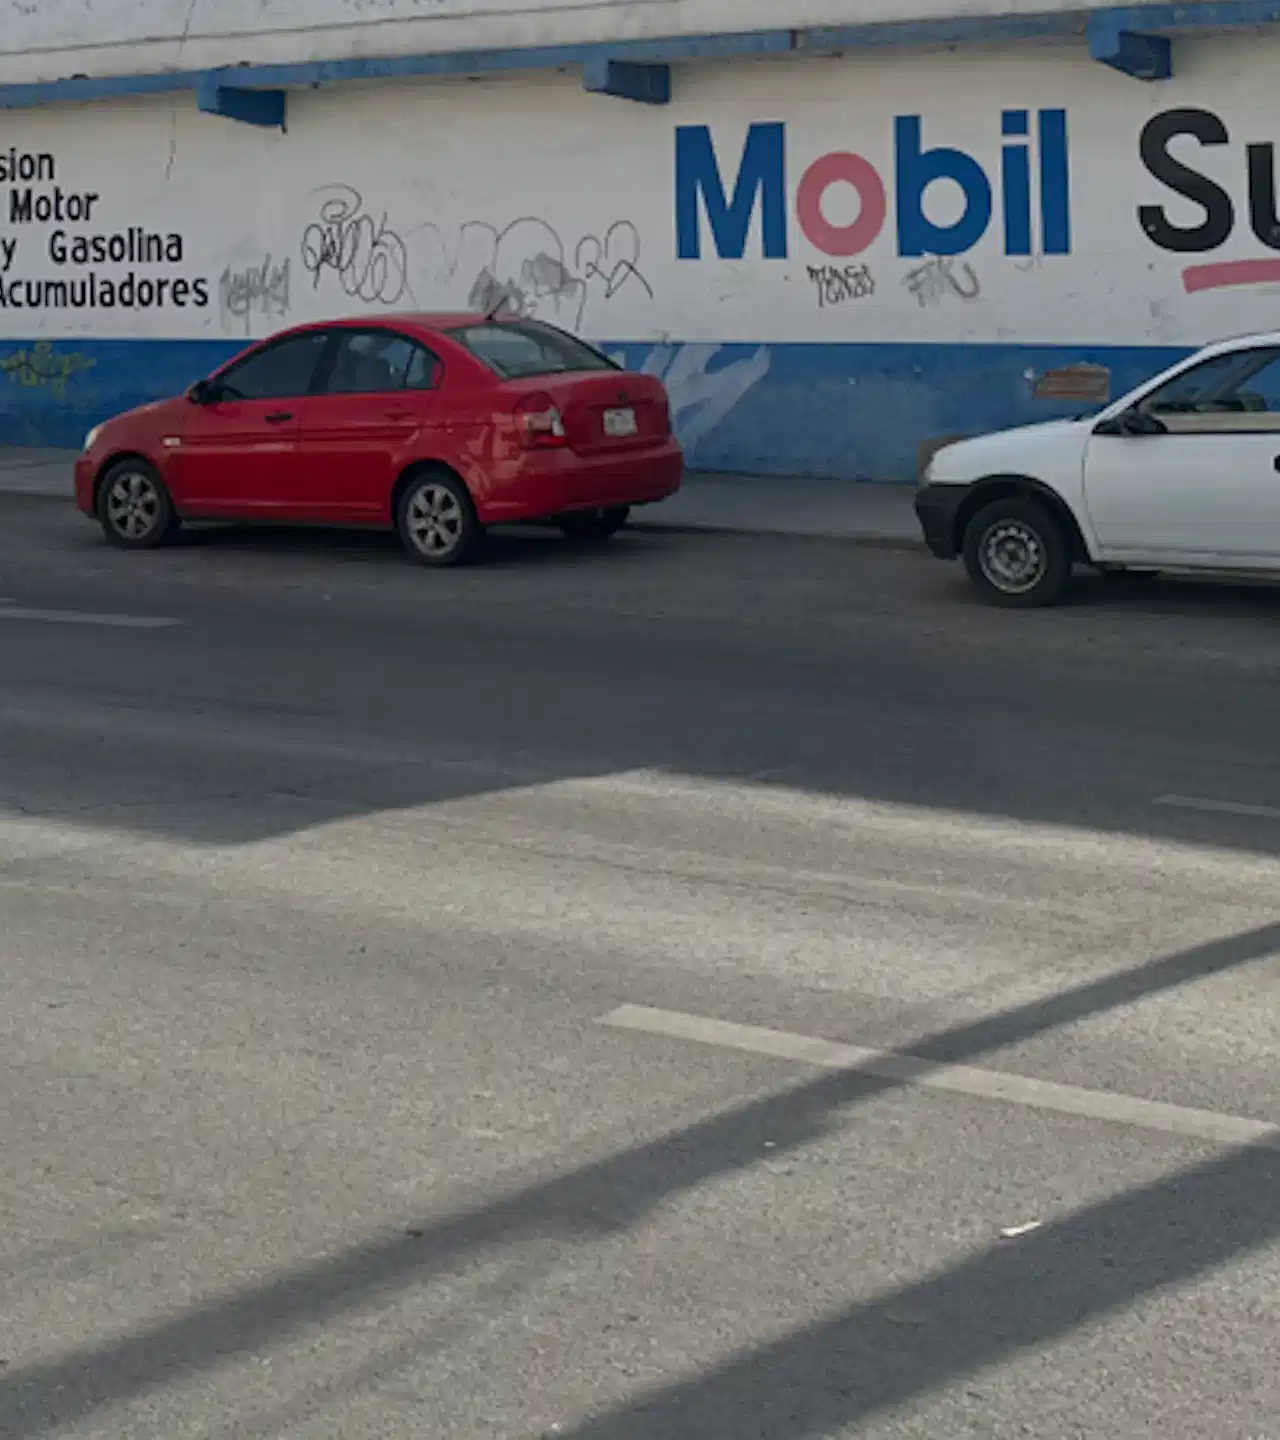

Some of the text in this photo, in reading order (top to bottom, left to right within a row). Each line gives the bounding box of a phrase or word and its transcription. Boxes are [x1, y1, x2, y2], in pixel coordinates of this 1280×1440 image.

[9, 186, 99, 224] Motor
[675, 109, 1071, 259] Mobil
[1, 238, 17, 271] y
[49, 227, 183, 265] Gasolina
